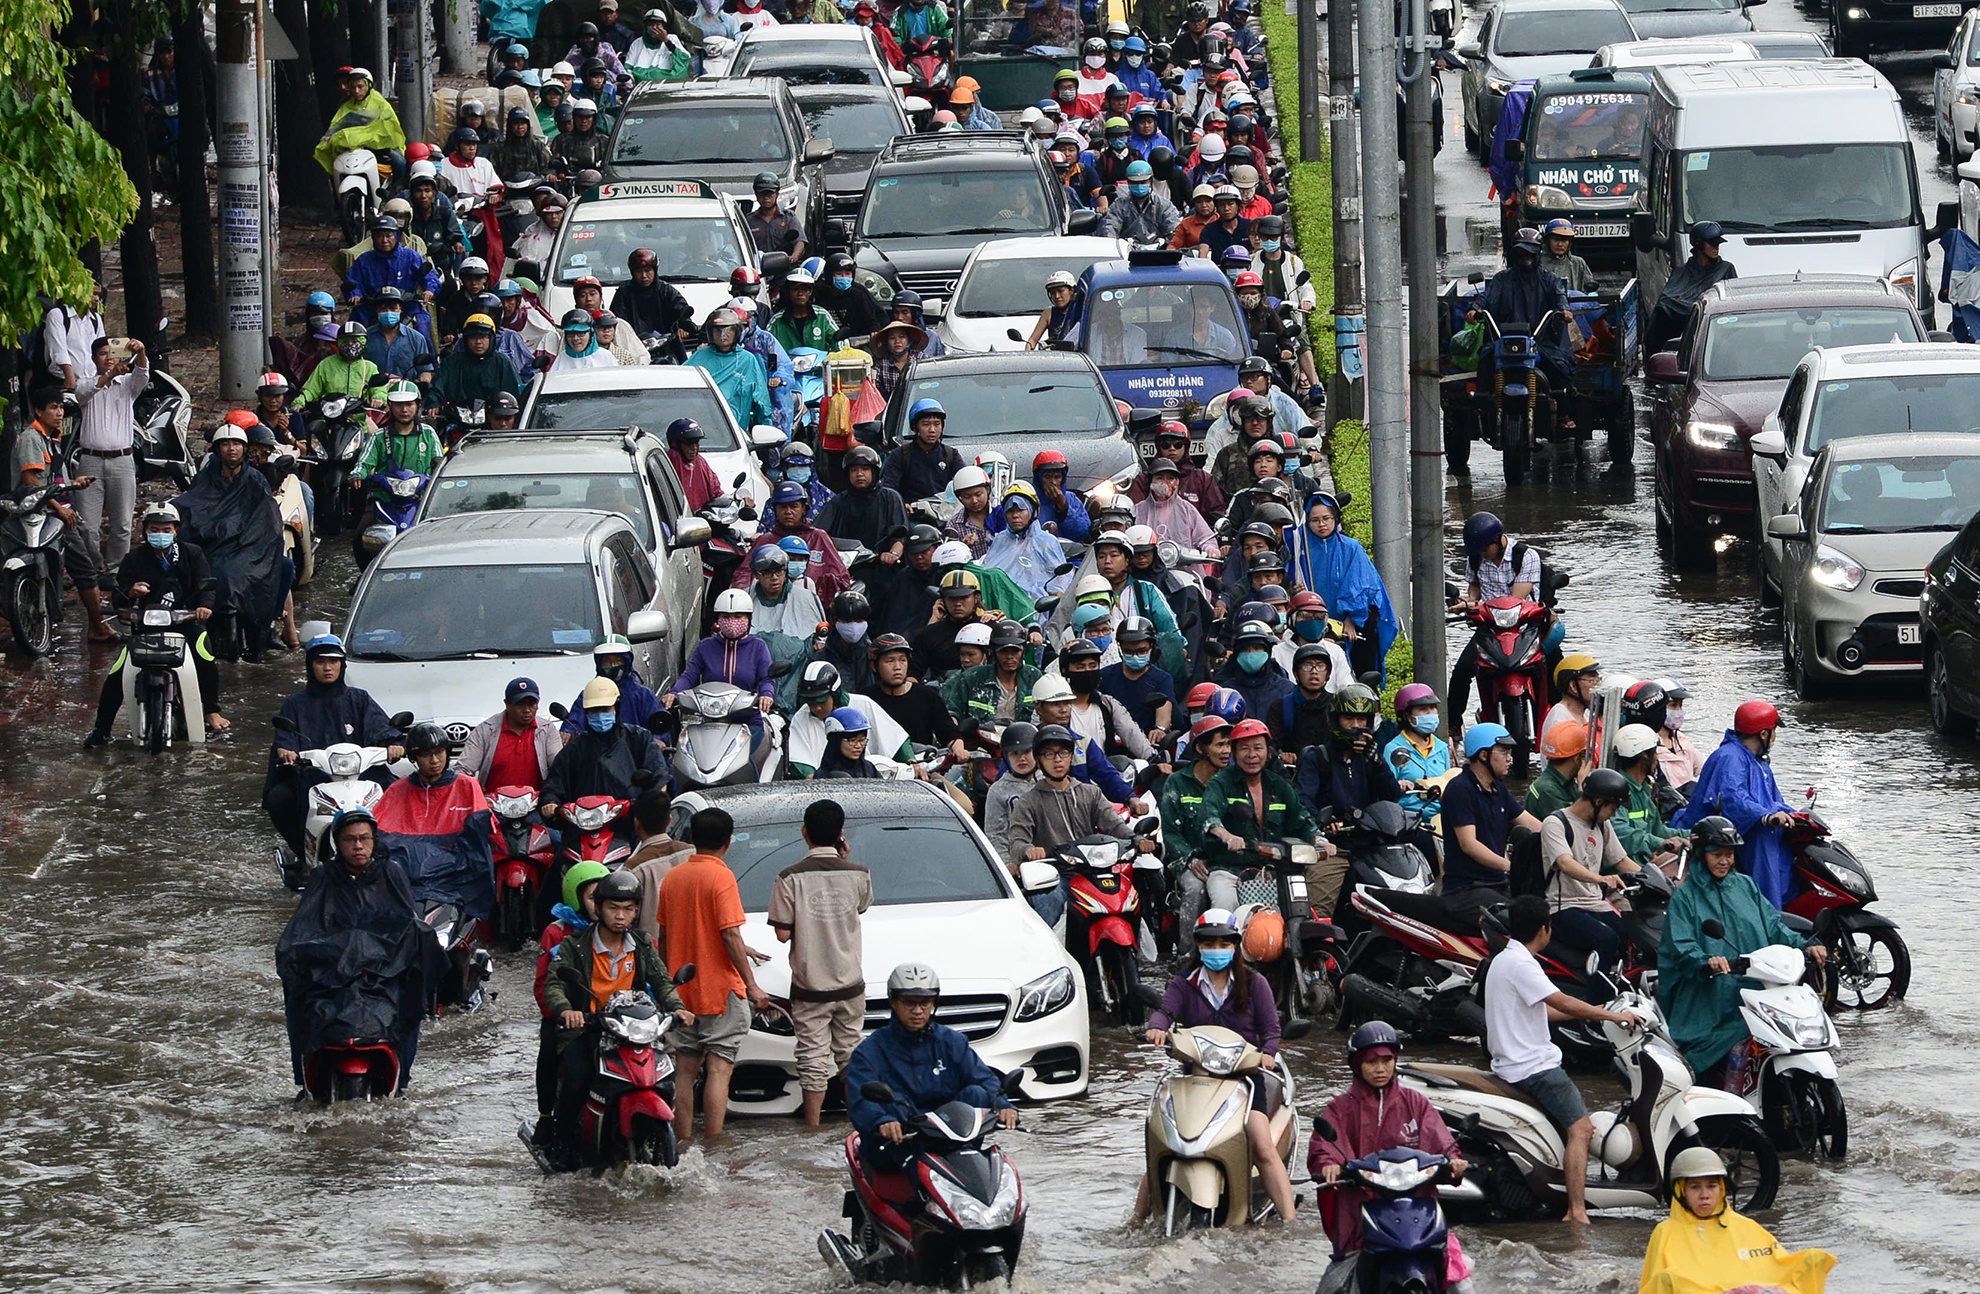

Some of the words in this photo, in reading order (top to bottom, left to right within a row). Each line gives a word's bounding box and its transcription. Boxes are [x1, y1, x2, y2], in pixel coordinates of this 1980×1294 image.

[1550, 94, 1633, 106] 0904975634
[1539, 168, 1578, 187] NHẬN
[1583, 165, 1615, 184] CHỞ
[623, 184, 674, 195] VINASUN
[675, 183, 699, 194] TAXI
[1128, 377, 1154, 390] NHẬN
[1156, 373, 1176, 387] CHỞ
[1178, 375, 1204, 387] HÀNG
